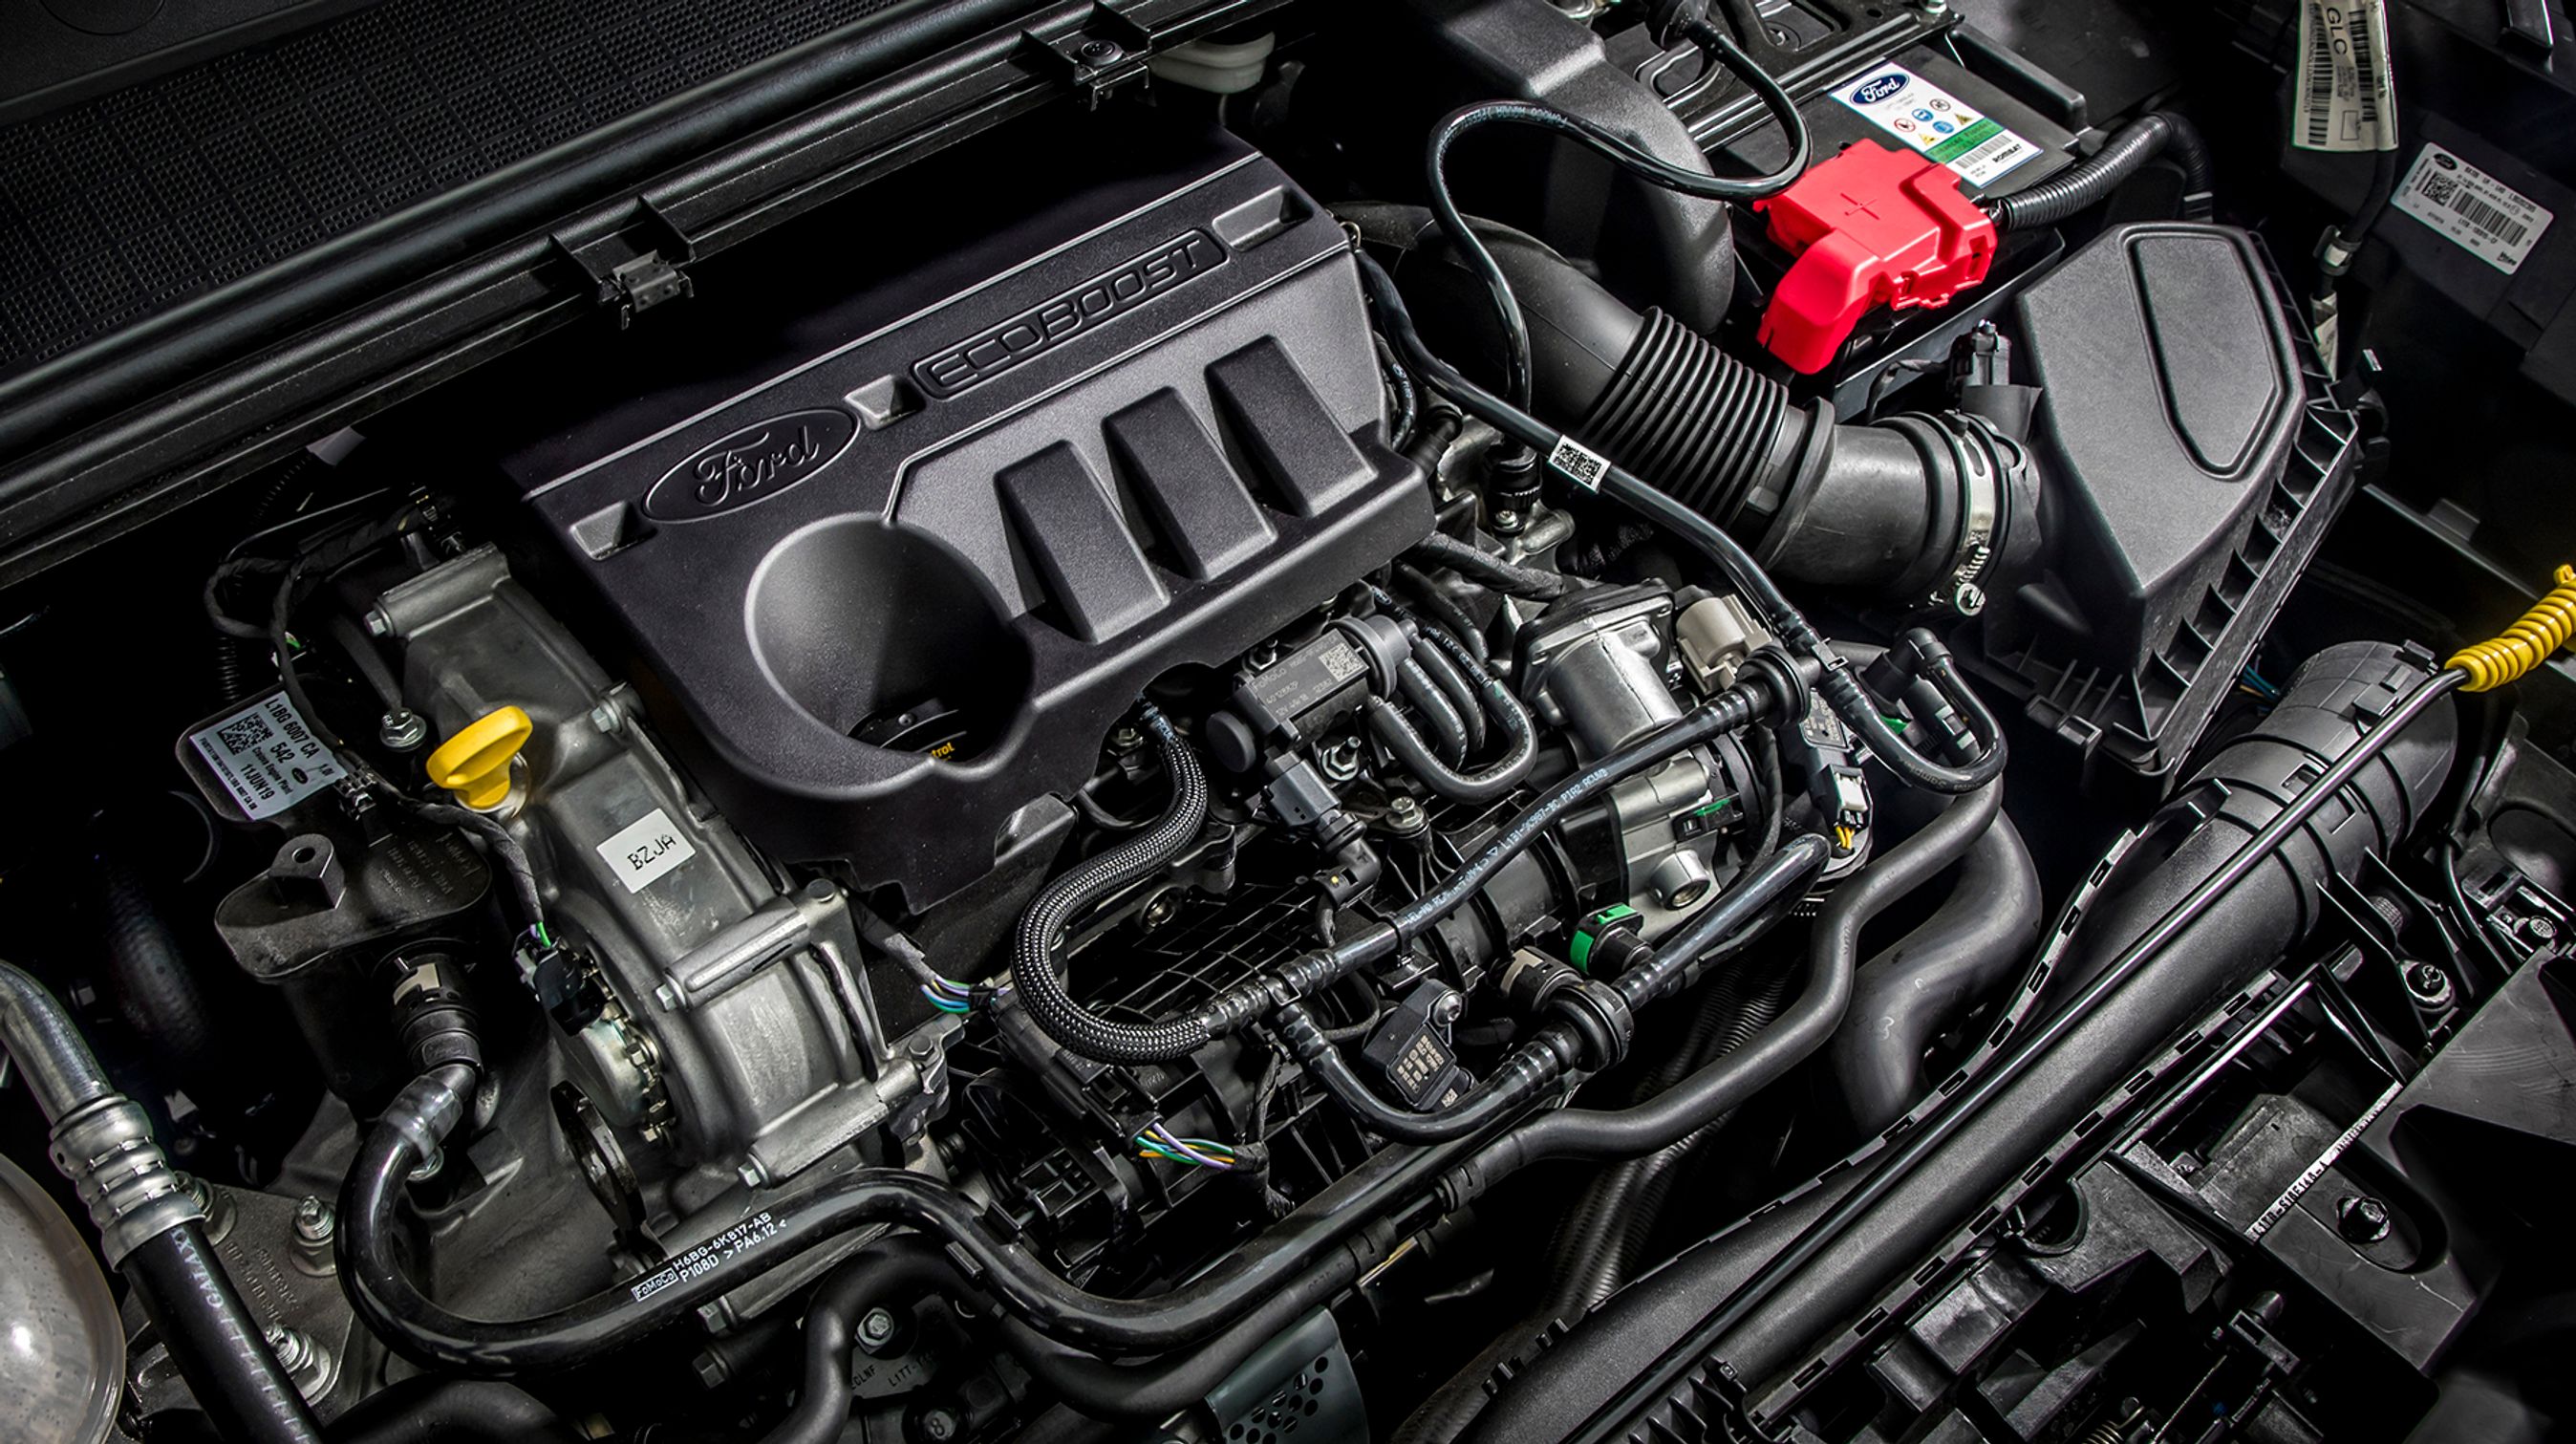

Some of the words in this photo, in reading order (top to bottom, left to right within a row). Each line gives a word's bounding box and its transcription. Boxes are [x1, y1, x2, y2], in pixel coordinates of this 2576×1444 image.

[2326, 7, 2349, 55] GLC
[1859, 77, 1900, 101] Ford
[692, 424, 819, 506] Ford
[264, 697, 292, 724] L1BG
[282, 719, 310, 745] 6007
[299, 741, 321, 759] CA
[268, 741, 296, 765] 542
[932, 742, 955, 758] trol
[239, 762, 275, 801] 11JUN19
[263, 763, 284, 782] Engine
[276, 778, 293, 795] Plant
[627, 833, 676, 871] BZJA
[679, 1254, 719, 1282] P108D
[633, 1269, 675, 1298] FoMoCo
[930, 1416, 946, 1436] 8
